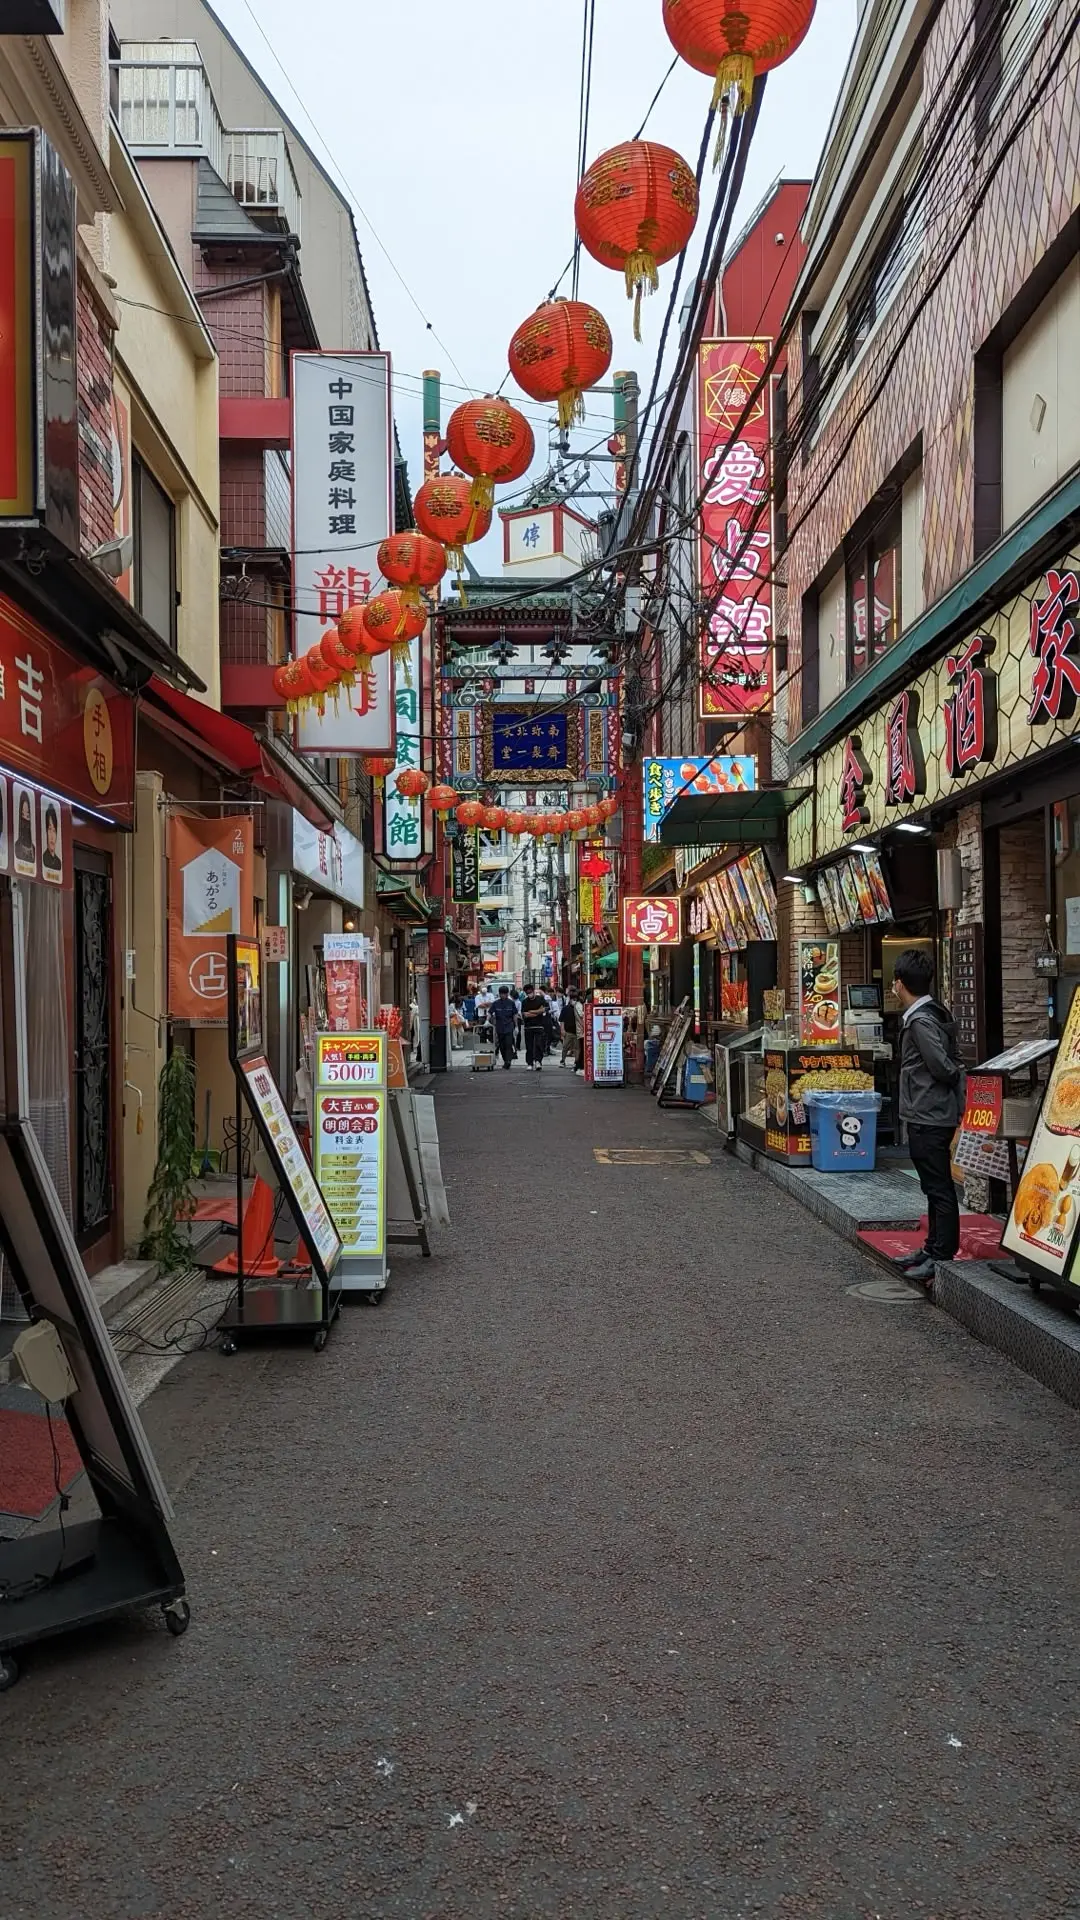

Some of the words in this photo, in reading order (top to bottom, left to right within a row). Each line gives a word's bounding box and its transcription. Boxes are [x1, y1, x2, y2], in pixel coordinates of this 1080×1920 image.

[328, 377, 357, 535] 中国家庭料理
[523, 522, 540, 548] 停
[703, 440, 770, 655] 愛占館
[312, 563, 378, 717] 龍
[15, 653, 44, 744] 吉
[842, 569, 1080, 833] 金鳳酒家
[92, 704, 107, 781] 手相
[387, 688, 420, 846] 同發館
[233, 829, 244, 855] 2階
[463, 826, 475, 893] 焼メロンパン
[206, 870, 220, 910] あがる
[640, 905, 668, 934] 占
[199, 956, 226, 991] 占
[322, 1042, 378, 1051] キャンペーン
[328, 1063, 374, 1081] 500円
[325, 1119, 376, 1131] 明朗会計
[328, 1101, 353, 1112] 大吉
[335, 1136, 364, 1144] 料金表
